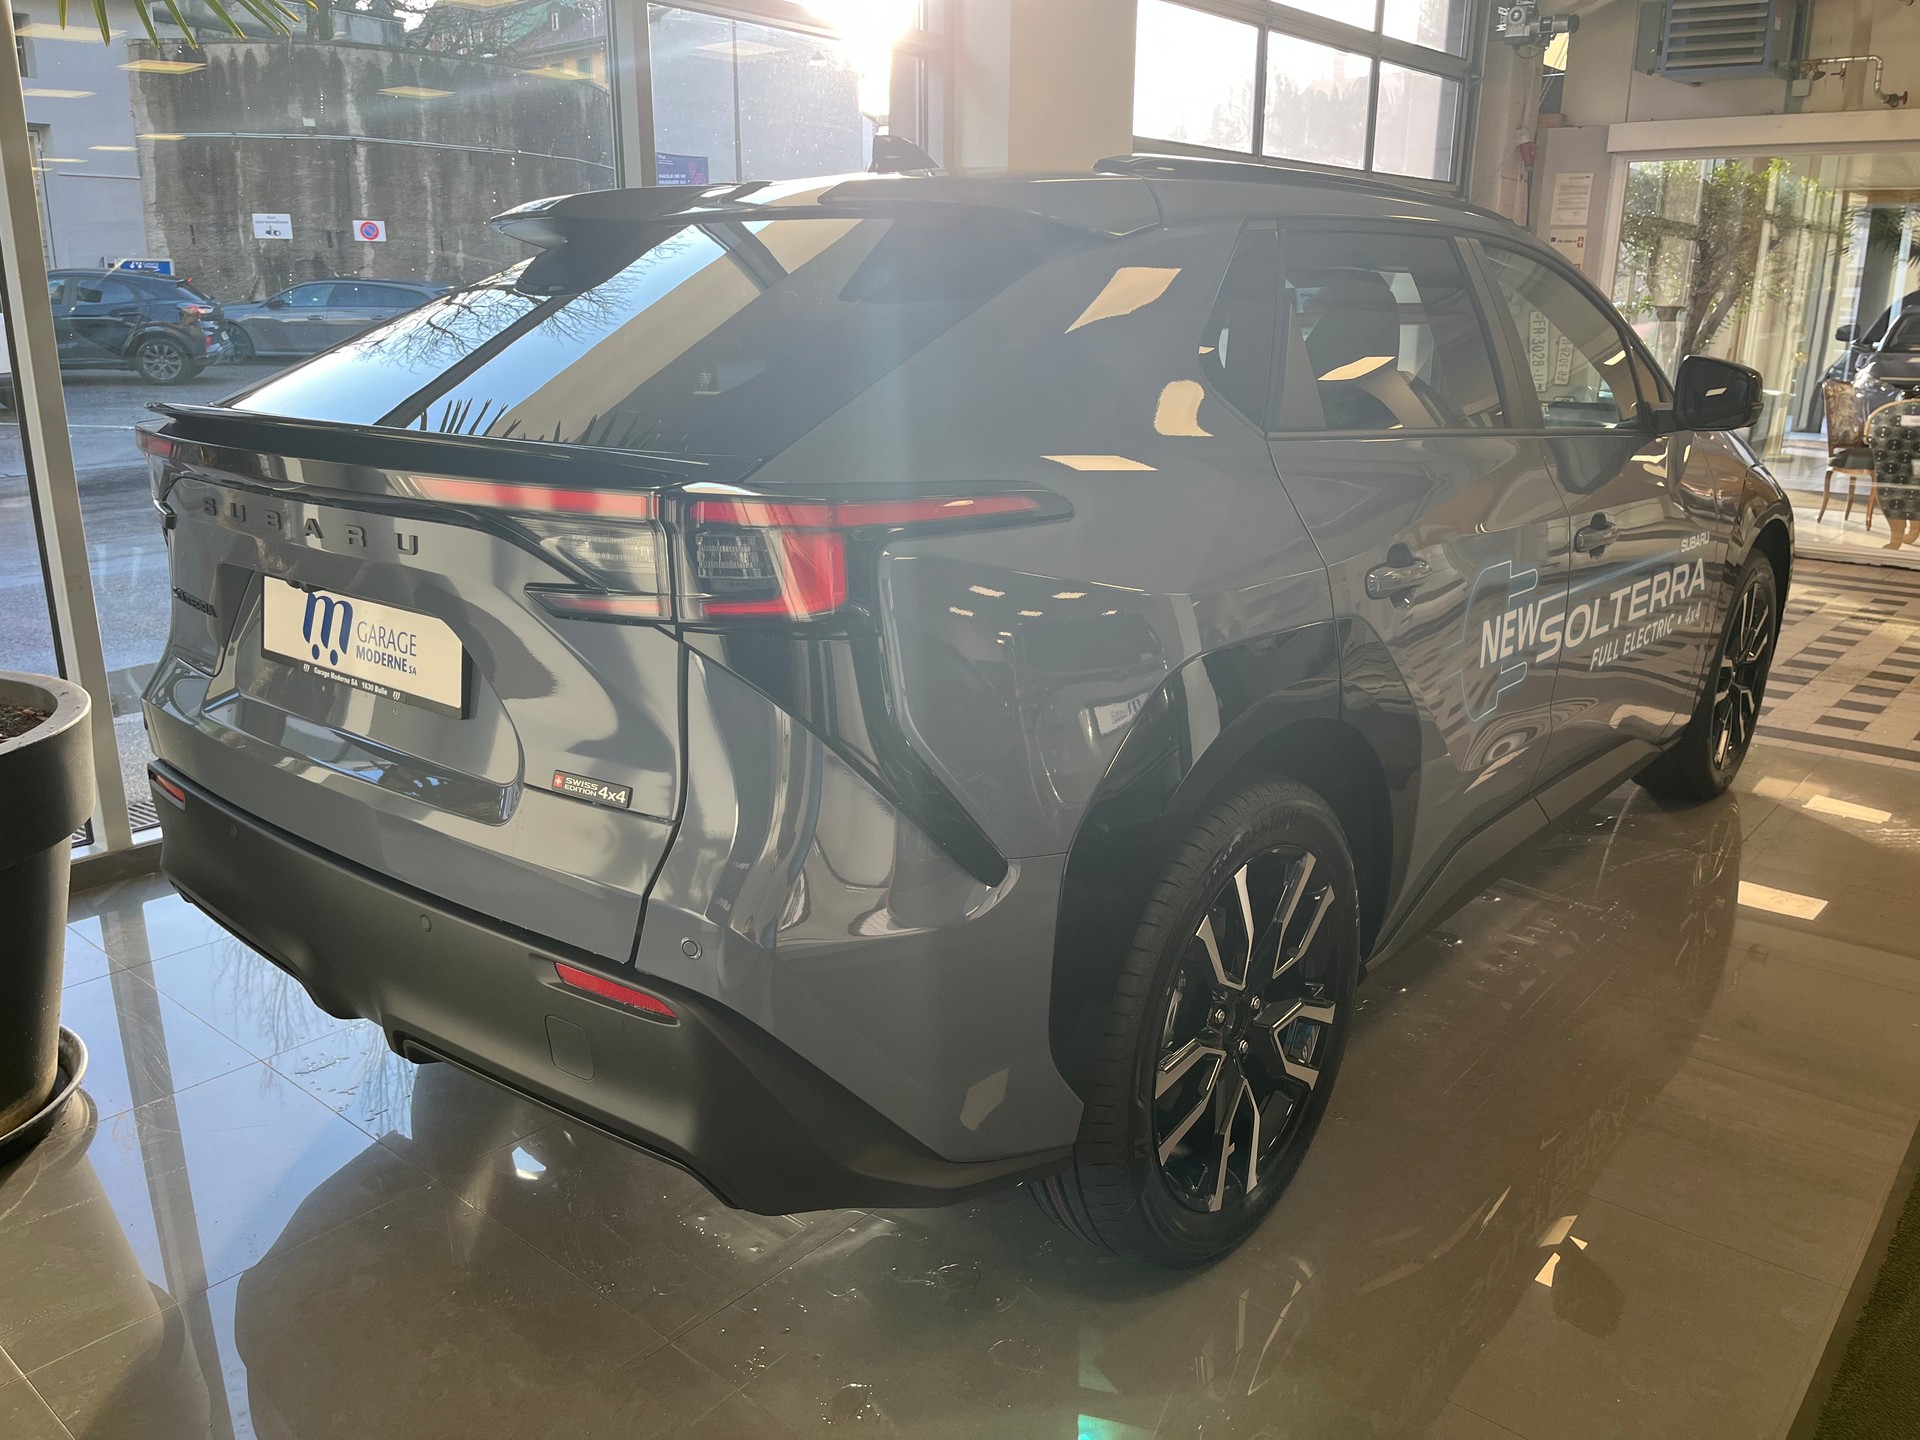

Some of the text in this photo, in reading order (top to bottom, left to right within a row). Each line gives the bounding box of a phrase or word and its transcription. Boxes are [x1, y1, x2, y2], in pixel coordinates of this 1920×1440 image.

[203, 497, 419, 556] SUBARU
[1681, 531, 1710, 553] SUBARU
[1480, 558, 1705, 669] NEW SOLTERRA
[357, 620, 417, 657] GARAGE
[1590, 601, 1702, 671] FULL ELECTRIC 4x4
[356, 645, 417, 676] MODERNE SA
[314, 667, 330, 679] Garage
[330, 671, 350, 685] Moderne
[350, 678, 358, 687] SA
[361, 681, 374, 692] 1630
[374, 685, 388, 696] Bulle
[564, 784, 597, 797] EDITION
[565, 777, 599, 791] SWISS
[598, 786, 626, 804] 4x4
